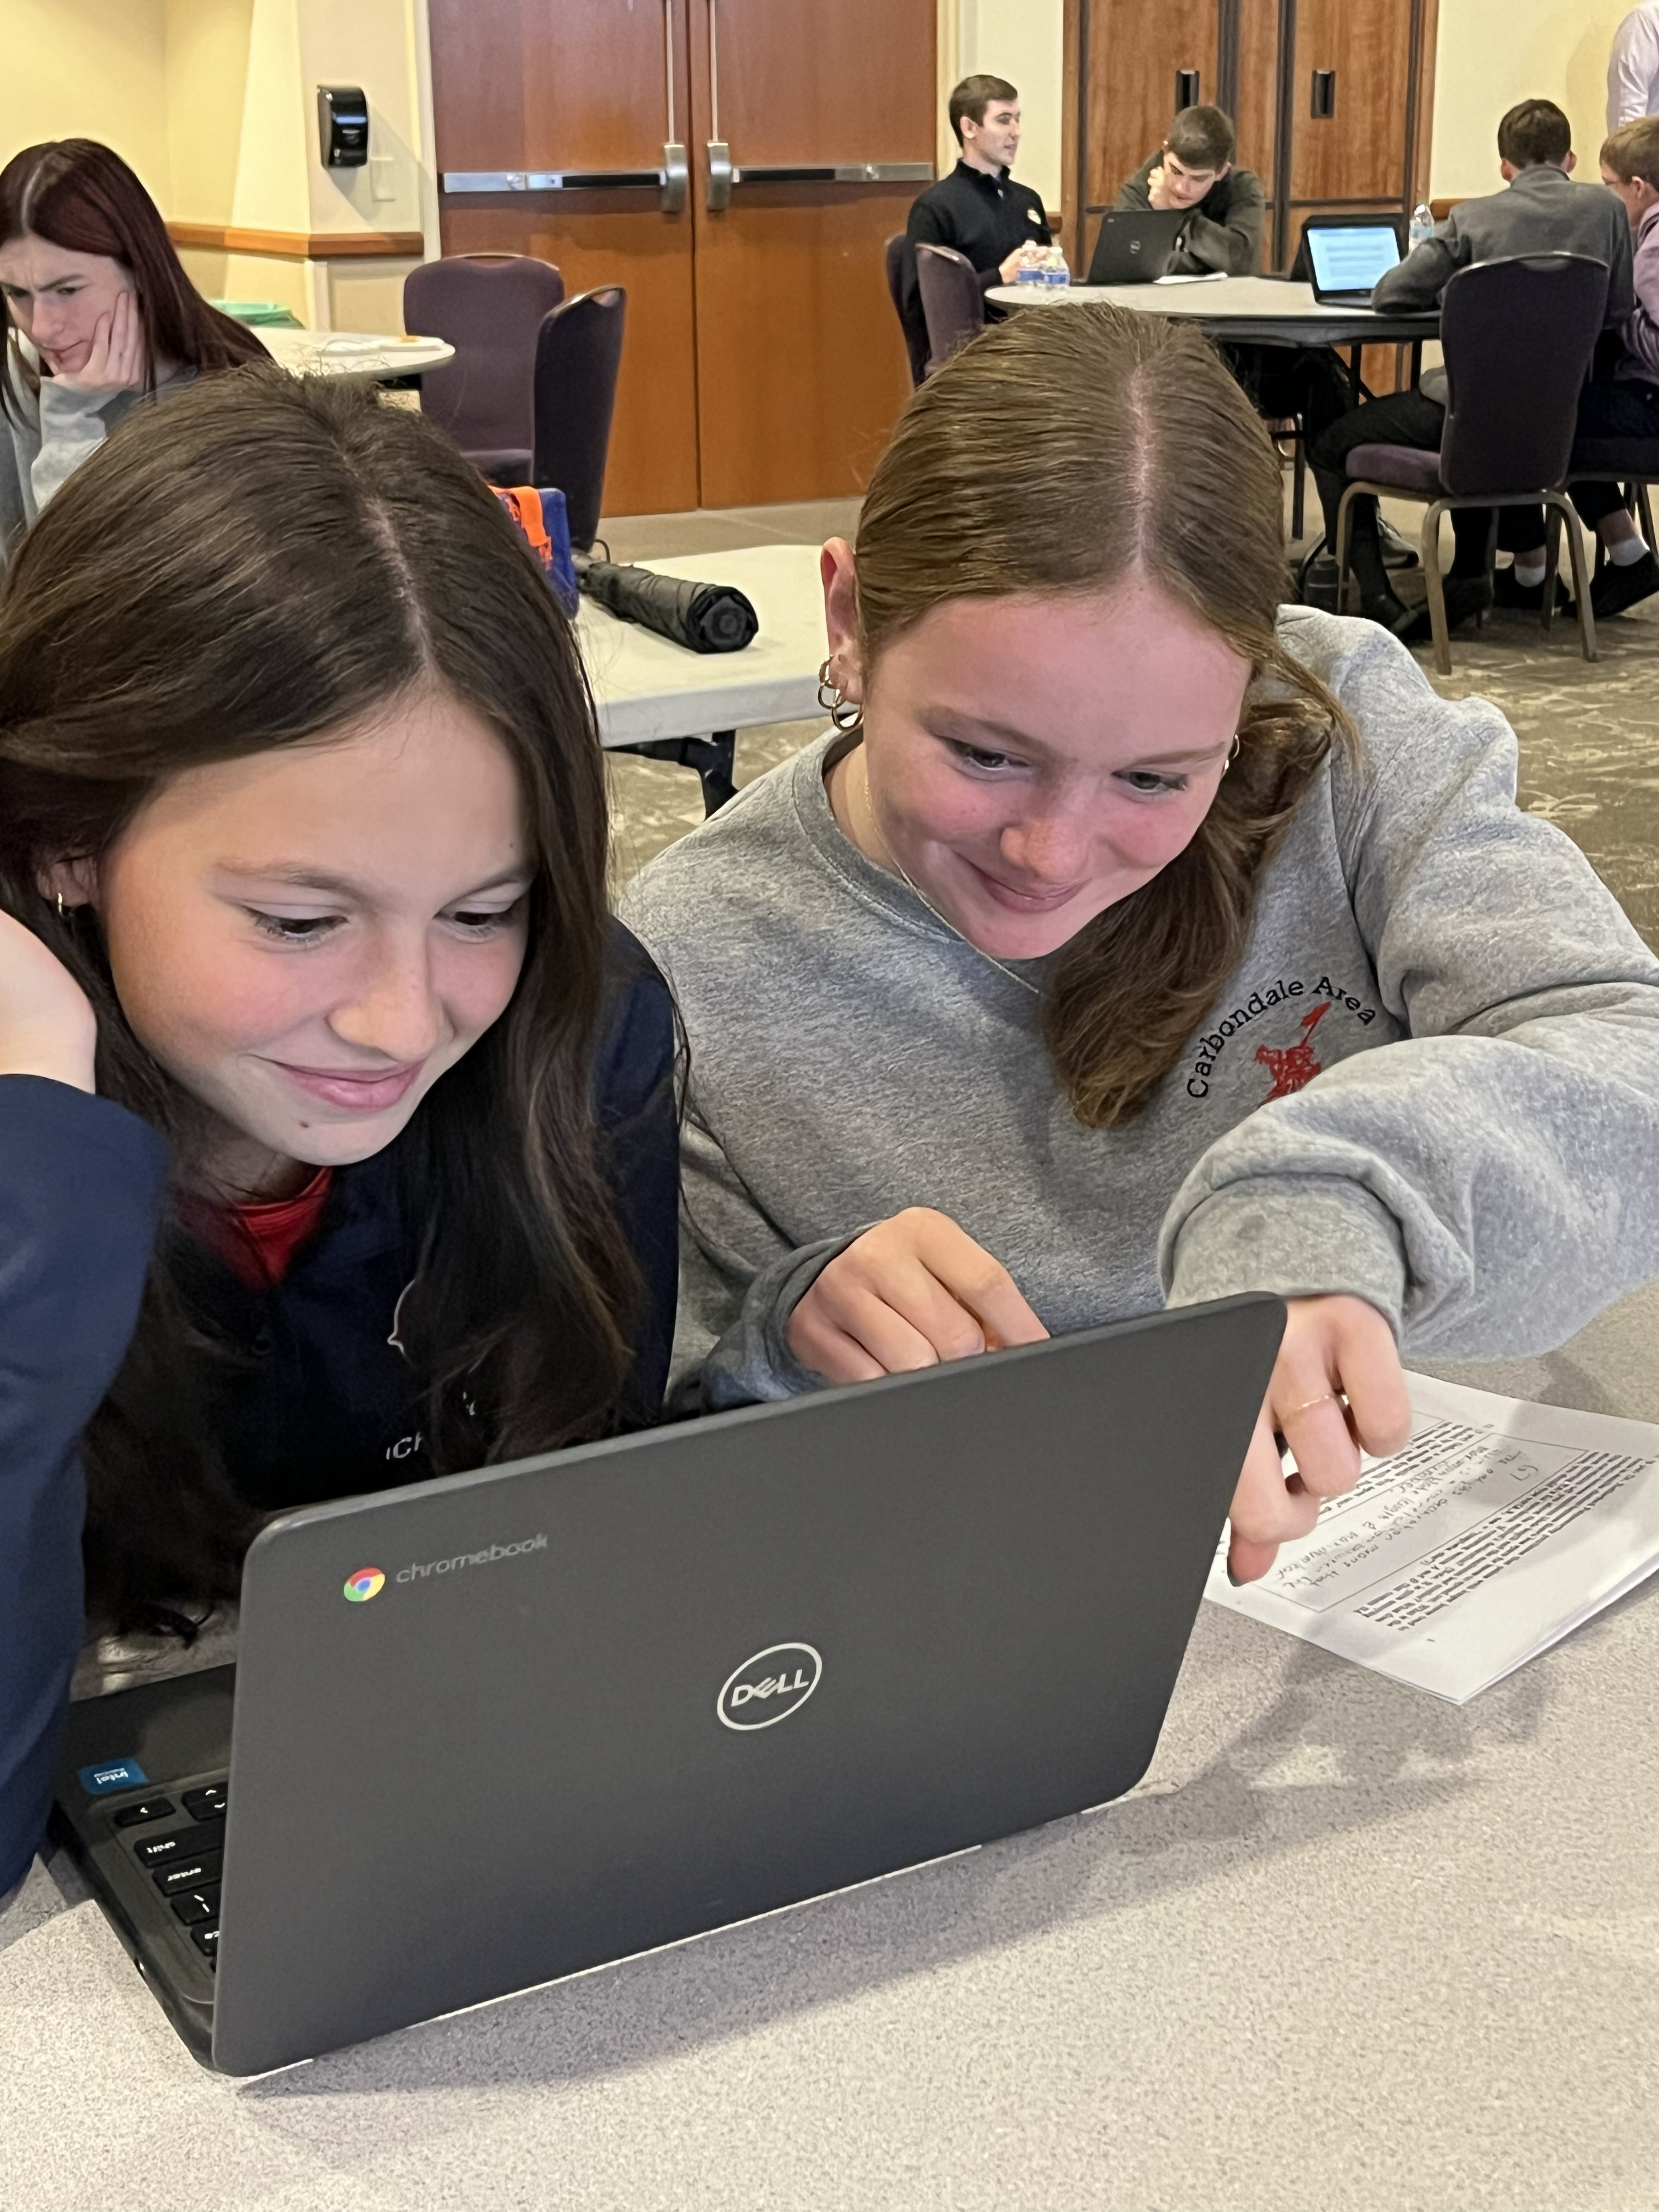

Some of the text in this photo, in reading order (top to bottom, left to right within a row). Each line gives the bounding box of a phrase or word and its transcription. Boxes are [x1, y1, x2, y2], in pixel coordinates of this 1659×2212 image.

[1187, 976, 1376, 1098] Carbondale Area
[396, 1533, 548, 1583] chromebook
[731, 1669, 809, 1707] DELL
